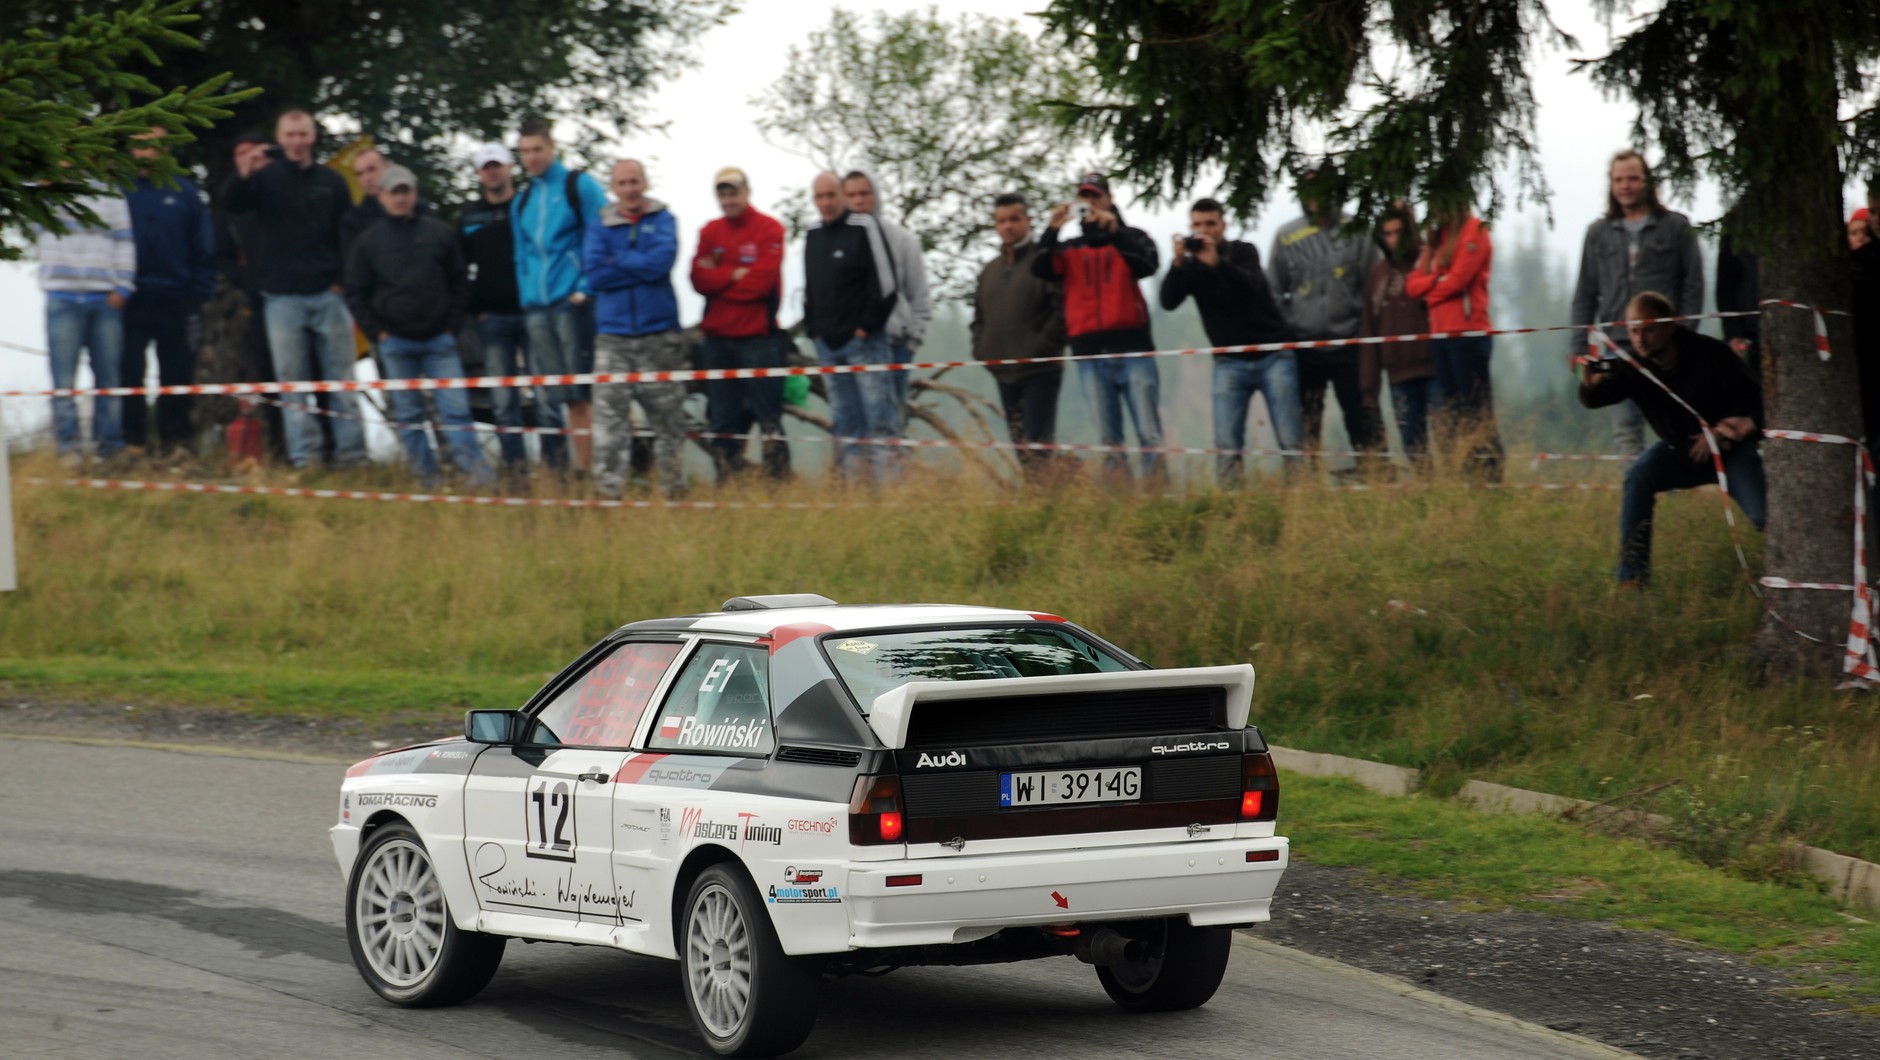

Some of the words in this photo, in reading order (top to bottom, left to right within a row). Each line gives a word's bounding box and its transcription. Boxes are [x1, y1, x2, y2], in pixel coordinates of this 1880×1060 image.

[699, 659, 740, 692] E1
[677, 716, 766, 748] Rowiński
[916, 751, 967, 768] Audi
[1151, 741, 1230, 755] quattro
[649, 769, 712, 783] quattro
[1016, 776, 1045, 802] WI
[1061, 771, 1138, 800] 3914G
[532, 781, 572, 852] 12
[788, 819, 832, 833] GTECHNIQ
[679, 807, 738, 848] Masters
[738, 812, 782, 852] Tuning
[769, 885, 838, 898] 4motorsport.pl
